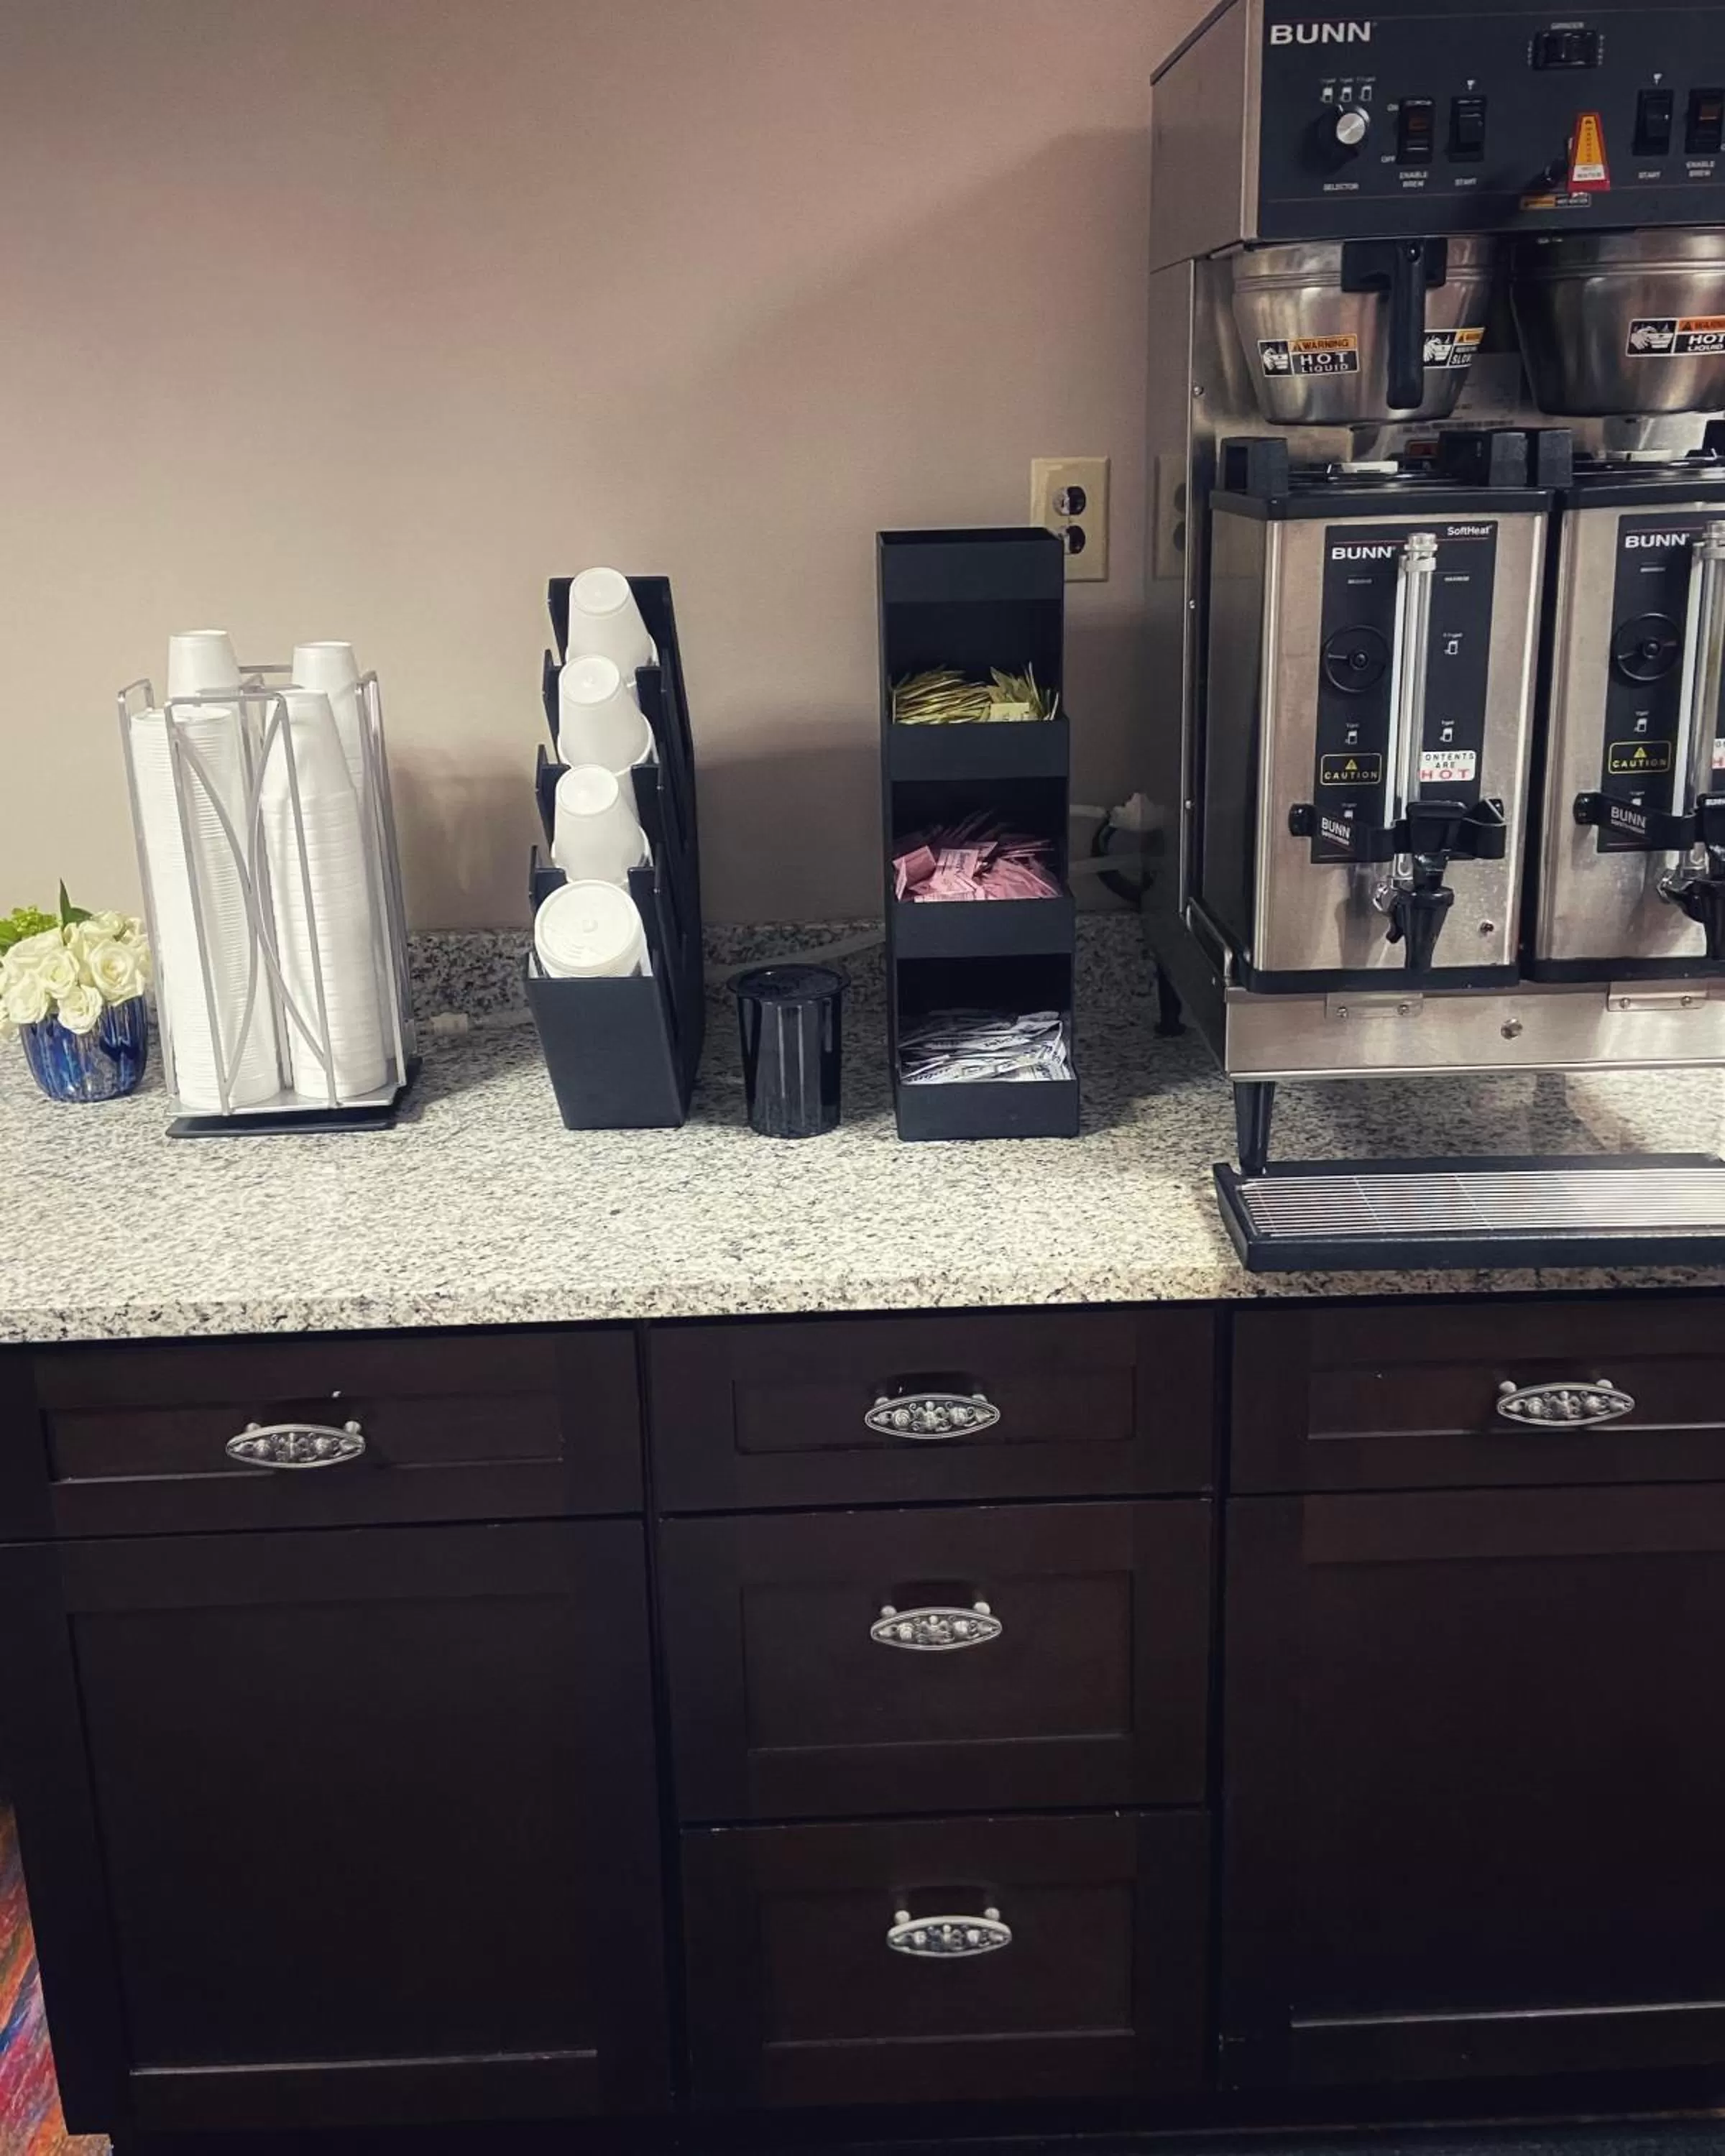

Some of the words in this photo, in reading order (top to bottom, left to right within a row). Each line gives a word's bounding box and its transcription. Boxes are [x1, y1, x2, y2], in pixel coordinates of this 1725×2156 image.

[1270, 21, 1371, 45] BUNN
[1303, 338, 1349, 349] WARNING
[1300, 352, 1348, 366] HOT
[1302, 363, 1348, 373] LIQUID
[1447, 526, 1489, 536] SoftHeat
[1625, 533, 1685, 548] BUNN
[1332, 546, 1392, 560] BUNN
[1612, 758, 1667, 768] CAUTION
[1324, 771, 1378, 780] CAUTION
[1421, 769, 1470, 779] HOT
[1611, 806, 1647, 829] BUNN
[1322, 817, 1351, 839] BUNN
